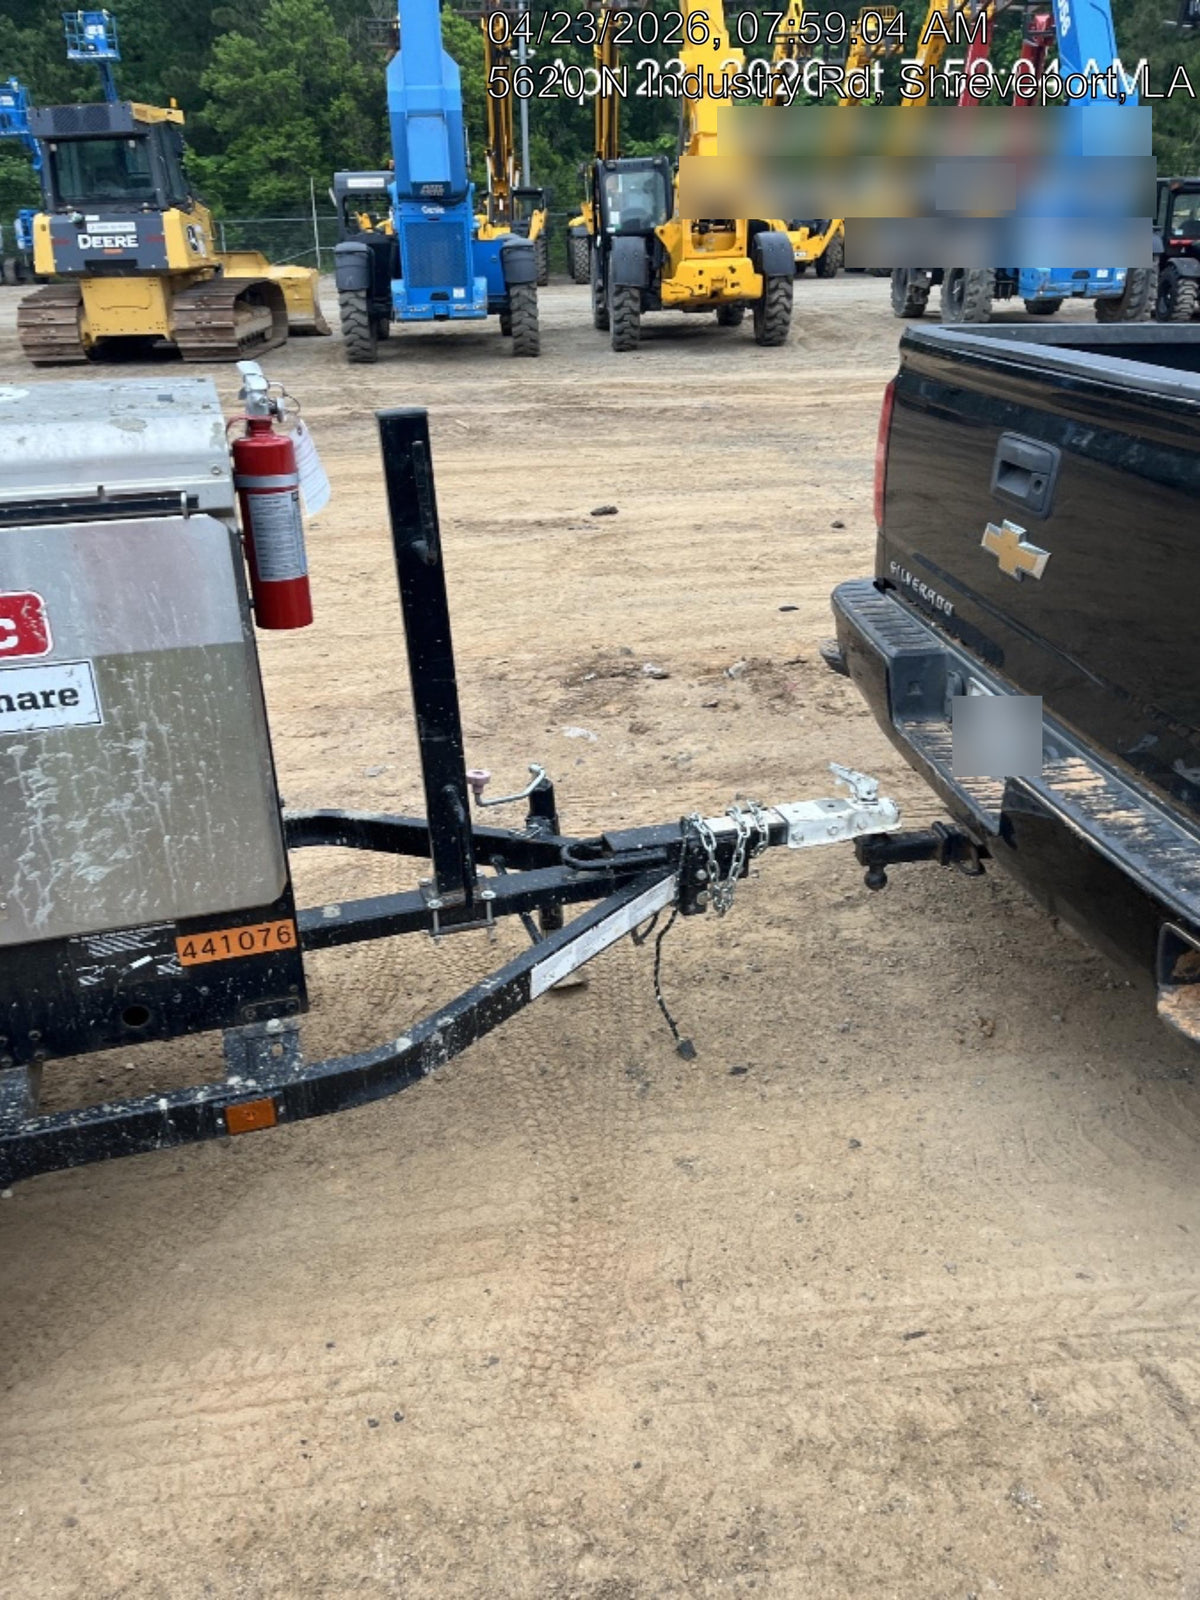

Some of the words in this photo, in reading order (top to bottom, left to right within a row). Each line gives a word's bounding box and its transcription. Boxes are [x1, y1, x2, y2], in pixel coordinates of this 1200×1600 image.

[77, 234, 139, 250] DEERE
[890, 561, 955, 617] SILVERADO
[181, 925, 293, 959] 441076
